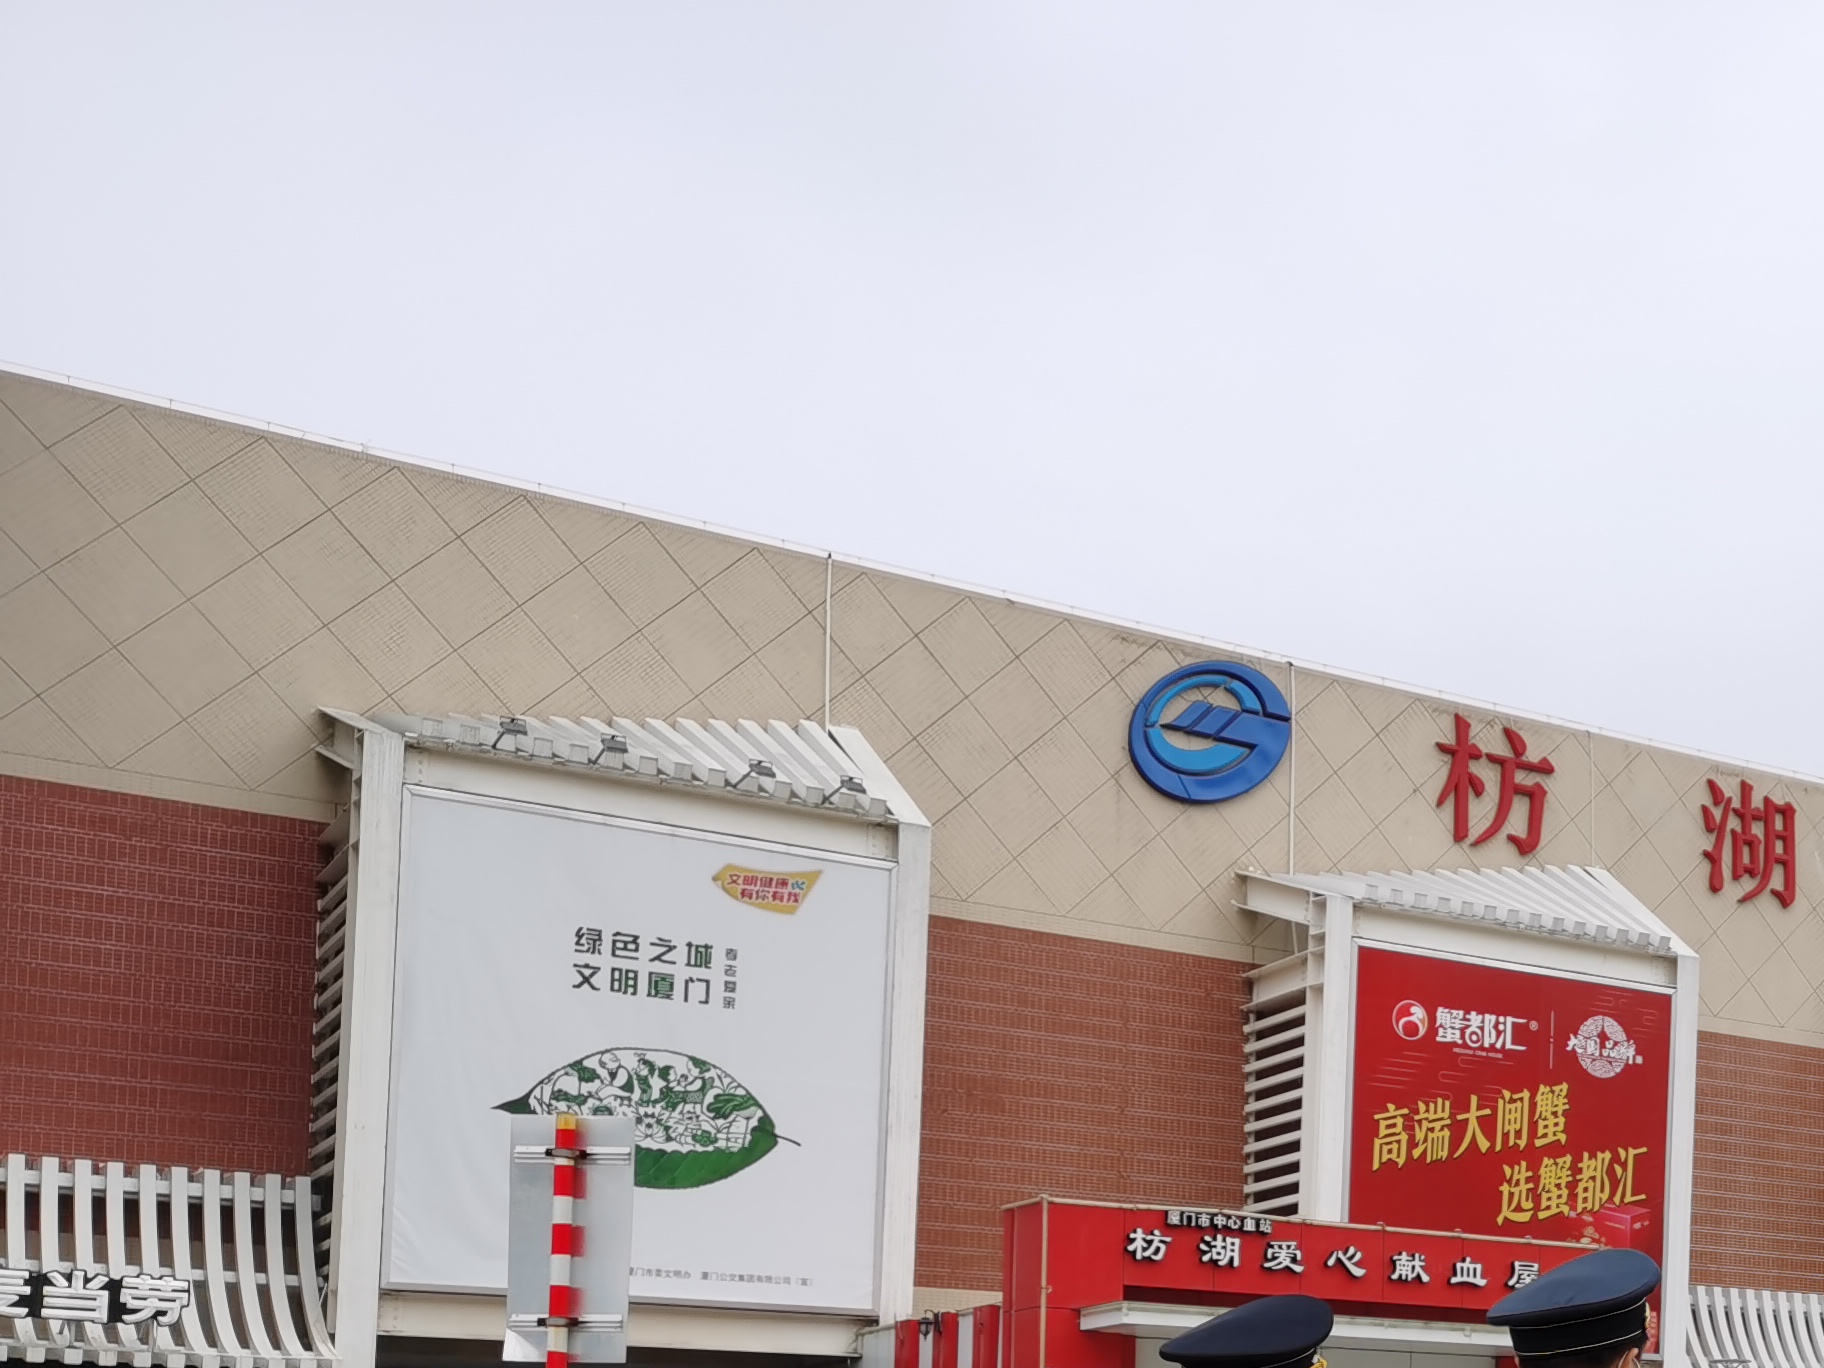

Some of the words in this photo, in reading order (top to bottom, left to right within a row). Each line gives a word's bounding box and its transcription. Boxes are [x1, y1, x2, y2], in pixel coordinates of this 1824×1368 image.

[726, 873, 790, 890] 文明健康
[573, 926, 714, 969] 绿色之城
[572, 962, 711, 1005] 文明厦门
[1434, 1006, 1528, 1051] 蟹都汇
[1371, 1081, 1570, 1172] 高端大闸蟹
[1496, 1146, 1649, 1226] 选蟹都汇
[1166, 1209, 1273, 1234] 厦门市中心血站
[1126, 1227, 1541, 1290] 枋湖爱心献血屋
